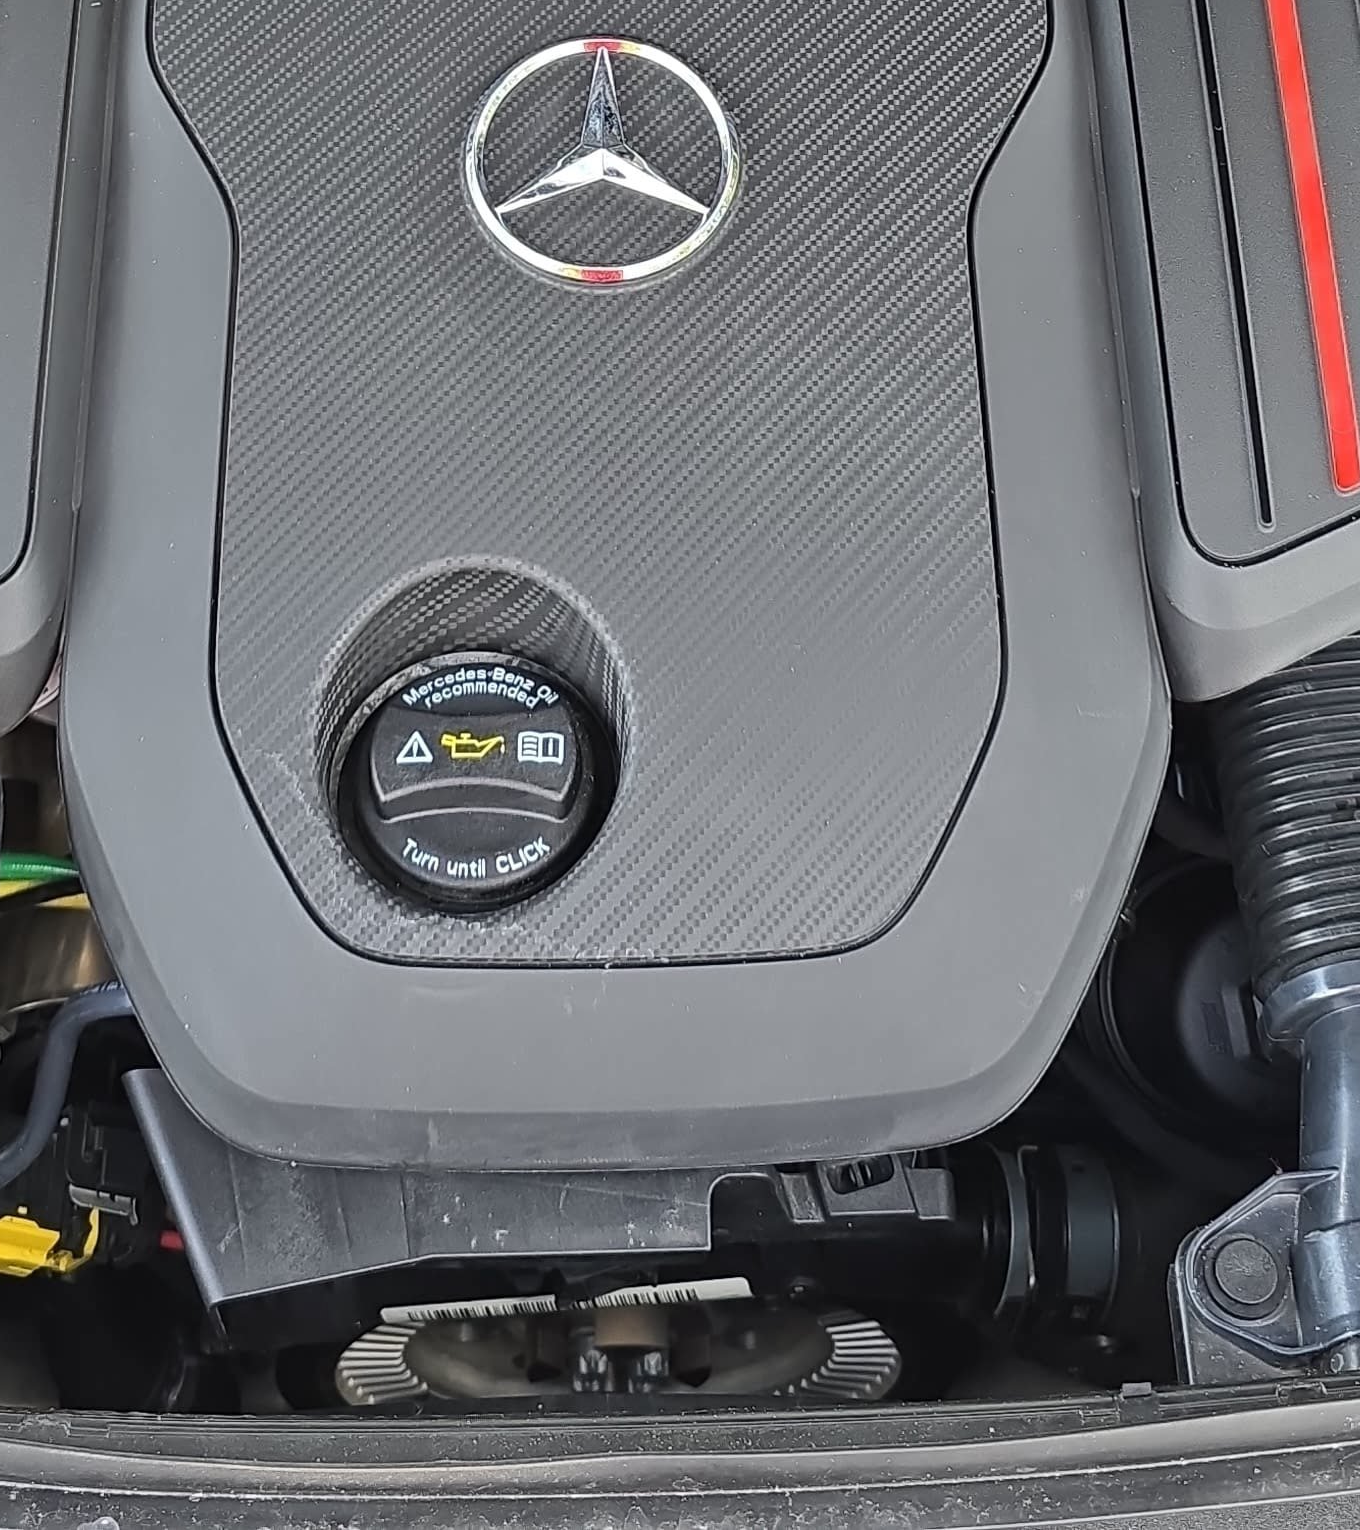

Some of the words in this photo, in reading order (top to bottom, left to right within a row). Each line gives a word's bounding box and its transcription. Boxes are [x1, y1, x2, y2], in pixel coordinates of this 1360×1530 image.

[402, 667, 535, 707] Mercedes-Benz
[536, 684, 559, 706] Oil
[424, 679, 539, 710] recommended
[402, 837, 439, 874] Turn
[446, 857, 487, 878] until
[495, 836, 552, 874] CLICK
